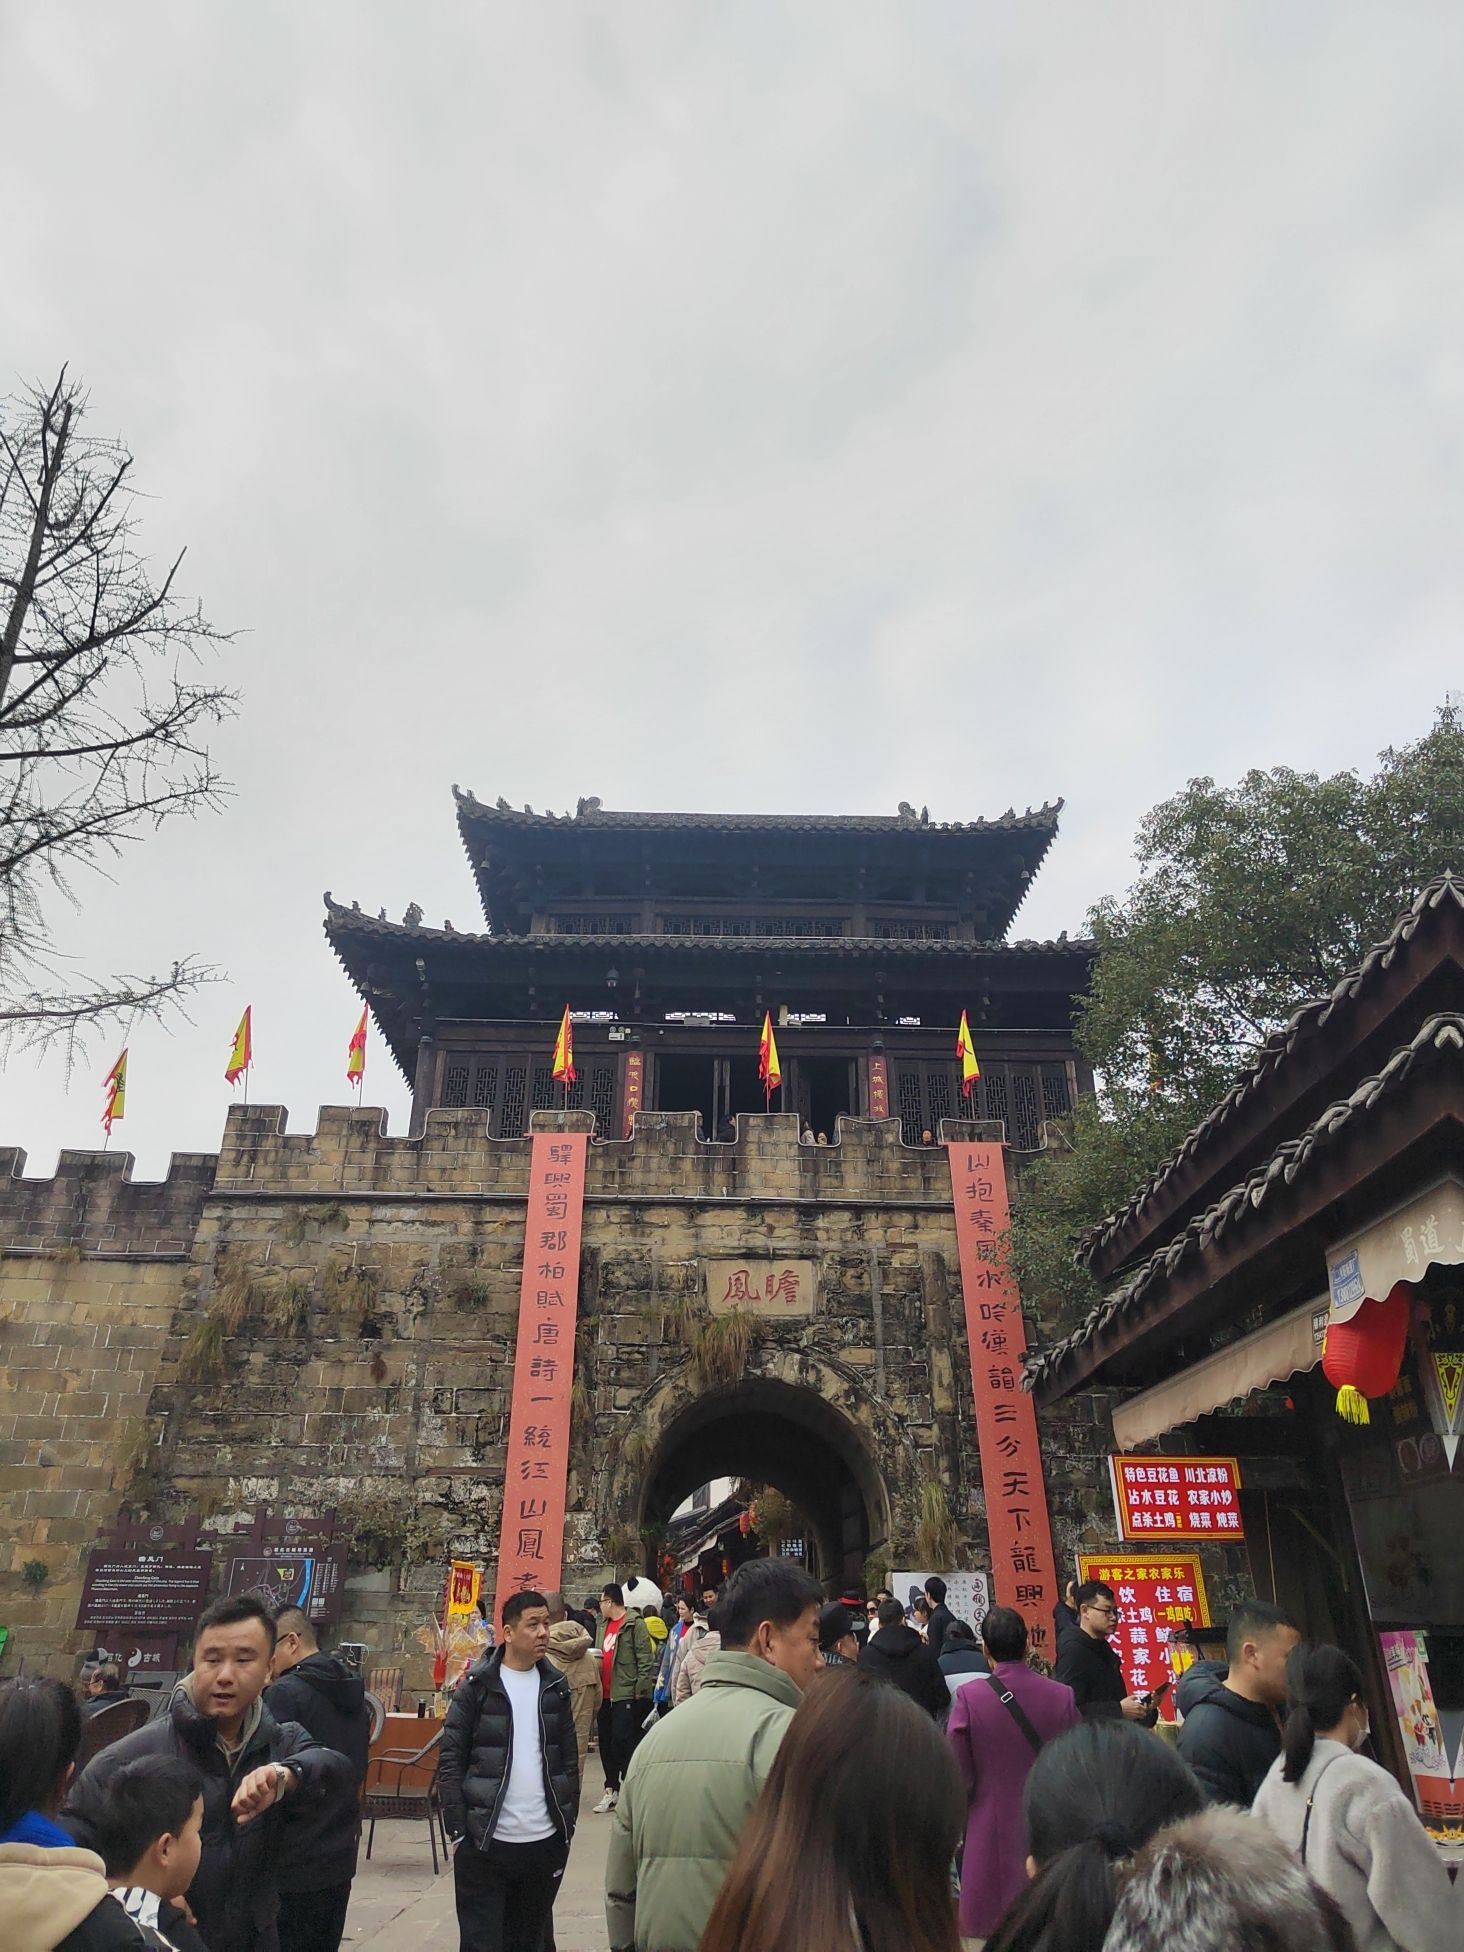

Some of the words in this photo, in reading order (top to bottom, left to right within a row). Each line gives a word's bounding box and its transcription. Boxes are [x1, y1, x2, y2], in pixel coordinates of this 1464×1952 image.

[1400, 1214, 1464, 1265] 蜀道
[1124, 1467, 1180, 1483] 特色豆花鱼
[1184, 1467, 1228, 1483] 川北凉粉
[1128, 1489, 1180, 1505] 沾水豆花
[1187, 1489, 1232, 1505] 农家小炒
[1132, 1511, 1175, 1528] 点杀土鸡
[1189, 1511, 1212, 1528] 烧菜
[1099, 1567, 1185, 1581] 游客之家农家乐
[1155, 1585, 1194, 1603] 住宿
